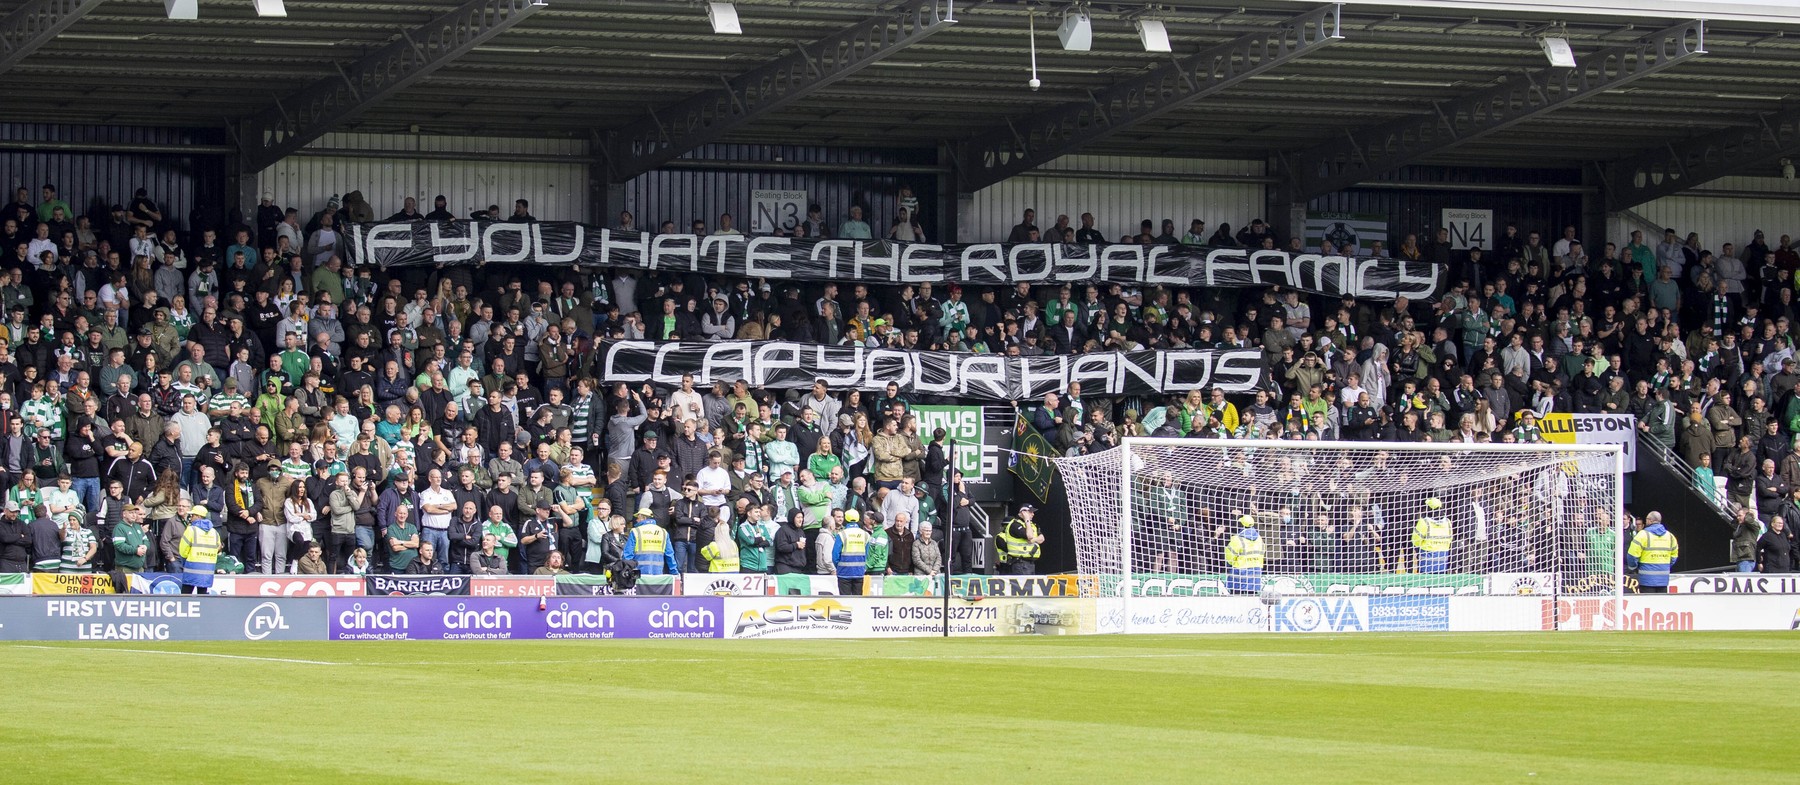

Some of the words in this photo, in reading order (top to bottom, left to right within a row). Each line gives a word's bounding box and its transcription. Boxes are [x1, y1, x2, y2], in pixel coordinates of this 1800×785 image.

[754, 191, 781, 200] Seating
[783, 191, 803, 200] Block
[757, 201, 799, 231] N3
[1447, 211, 1470, 220] Seating
[1449, 222, 1486, 248] N4
[353, 222, 412, 264] IF
[430, 221, 584, 263] YOU
[601, 228, 791, 278] HATE
[810, 239, 944, 282] THE
[960, 243, 1190, 285] ROYAL
[1205, 249, 1439, 300] FAMILY
[604, 340, 800, 386] CLAP
[815, 345, 1007, 398] YOUR
[1020, 350, 1262, 399] HANDS
[910, 409, 977, 437] HOYS
[1534, 417, 1632, 434] AILLIESTON
[55, 575, 114, 587] JOHNSTON
[375, 577, 463, 592] BARRHEAD
[743, 576, 763, 591] 27
[474, 585, 505, 596] HIRE
[518, 585, 556, 596] SALES
[47, 600, 106, 617] FIRST
[110, 600, 201, 617] VEHICLE
[339, 602, 409, 629] cinch
[443, 602, 512, 629] cinch
[546, 602, 615, 628] cinch
[648, 602, 715, 628] cinch
[871, 606, 893, 619] Tel:
[899, 606, 942, 619] 01505
[948, 606, 997, 619] 327711
[1399, 606, 1419, 617] 355
[255, 615, 290, 630] FVL
[732, 604, 853, 637] ACRE
[872, 623, 995, 633] www.acreindutrial.co.uk
[78, 622, 170, 640] LEASING
[762, 628, 782, 636] British
